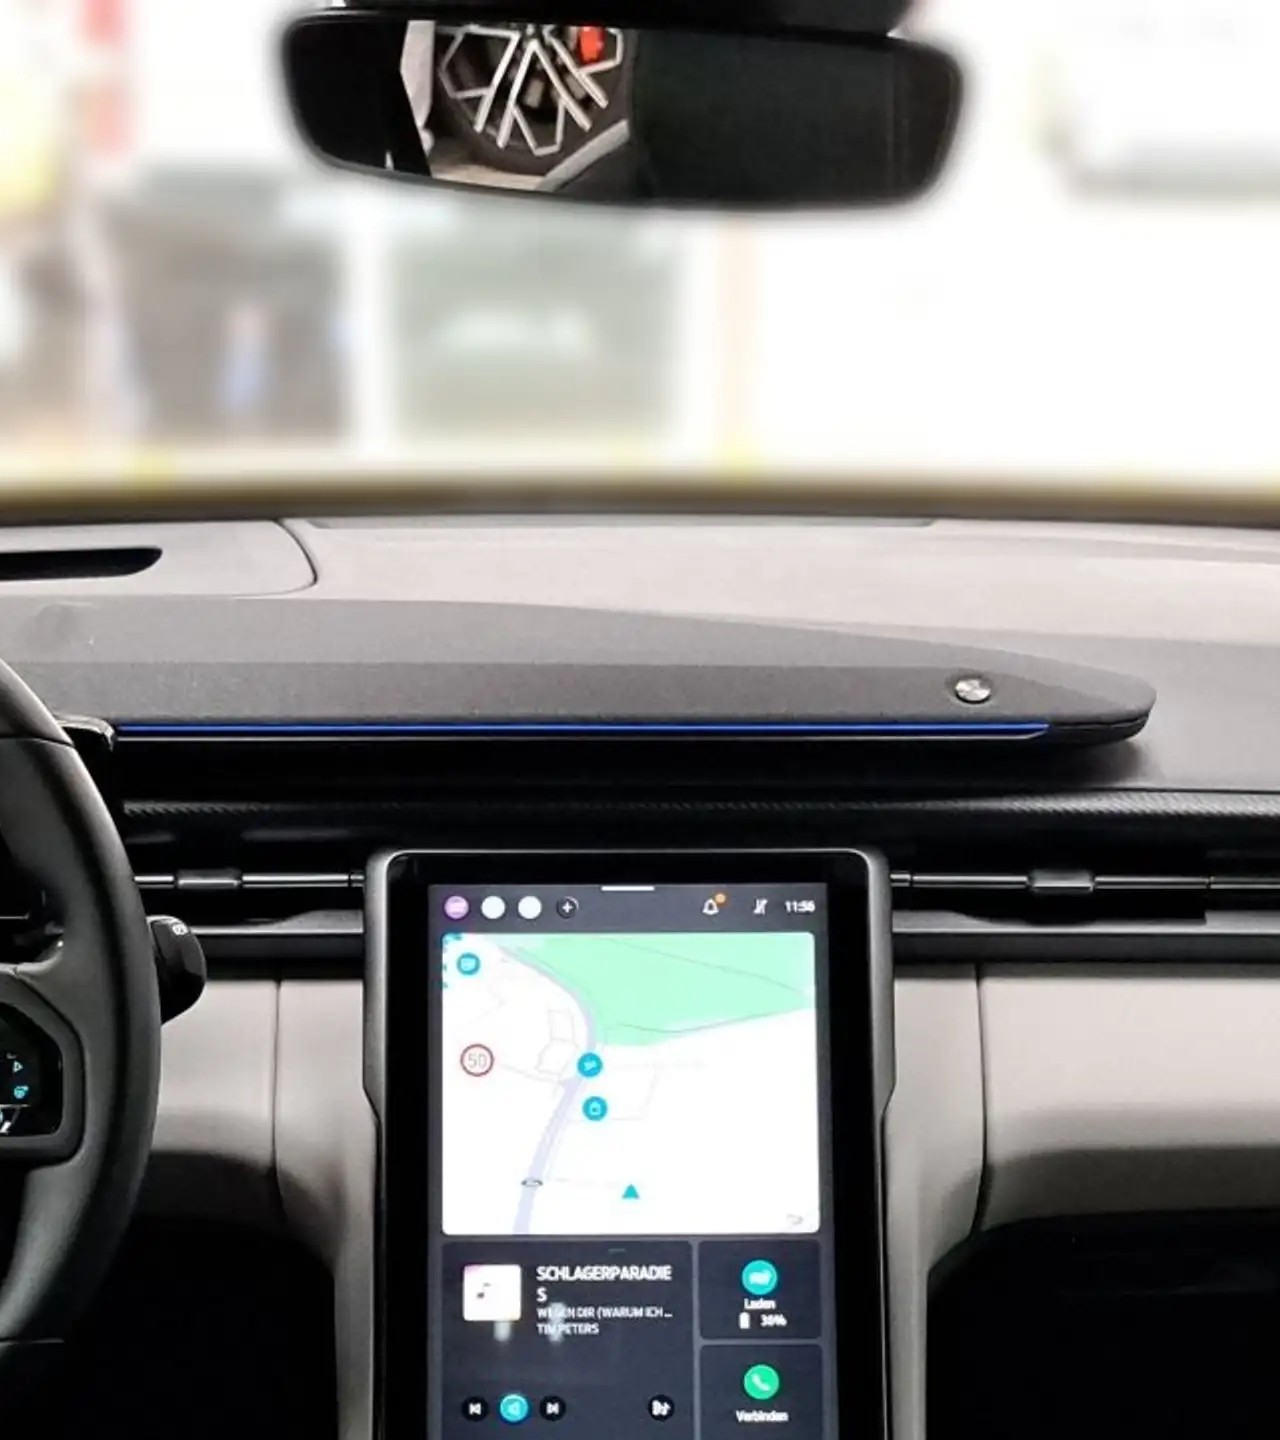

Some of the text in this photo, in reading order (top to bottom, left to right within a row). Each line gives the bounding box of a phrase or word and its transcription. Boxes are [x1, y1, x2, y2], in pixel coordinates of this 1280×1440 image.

[468, 1053, 488, 1069] 50
[536, 1265, 673, 1281] SCHLAGERPARADIE
[536, 1286, 548, 1302] S
[744, 1298, 776, 1310] Laden
[736, 1410, 789, 1423] Verbinden
